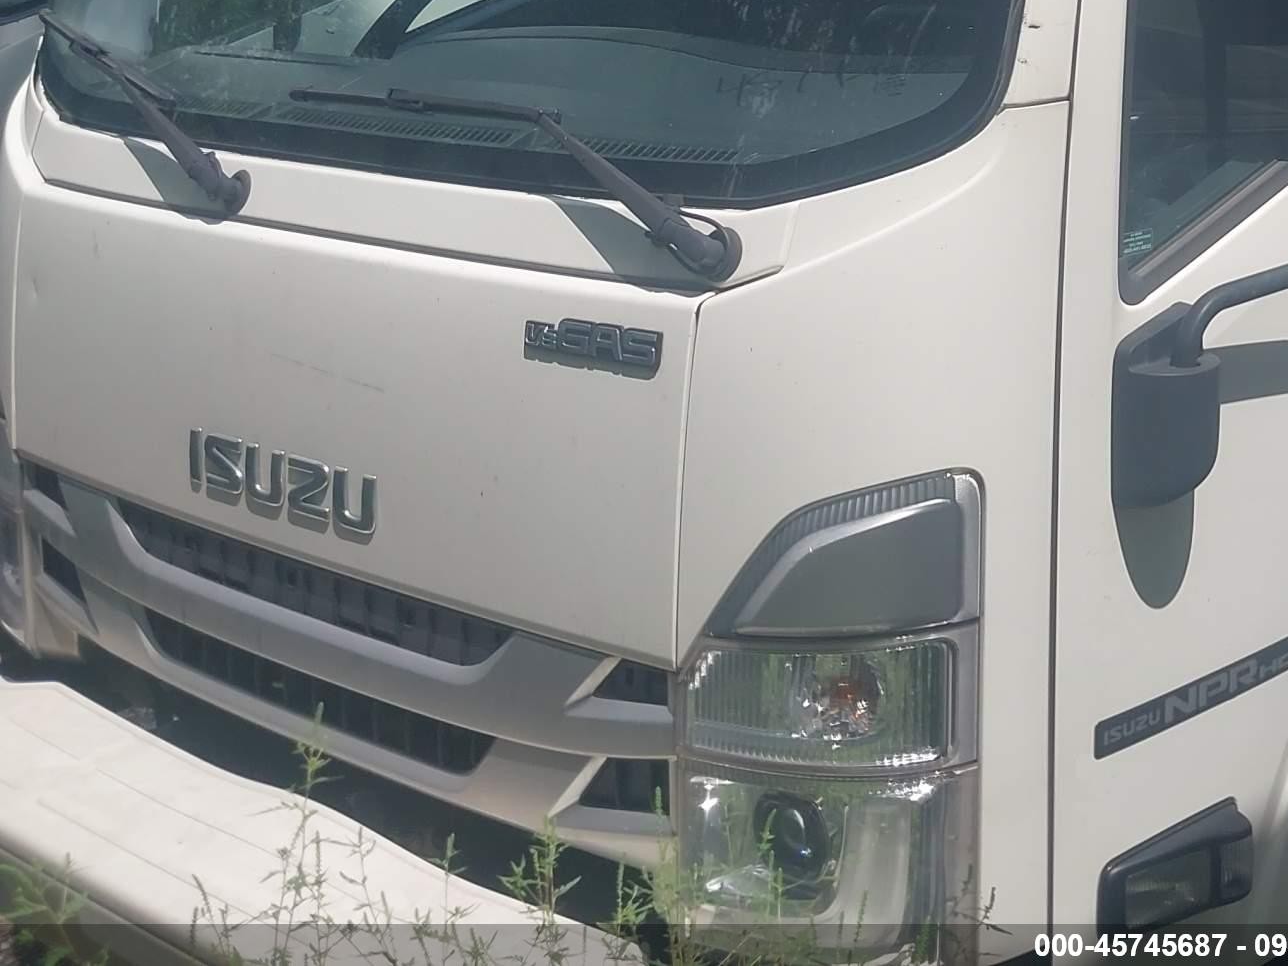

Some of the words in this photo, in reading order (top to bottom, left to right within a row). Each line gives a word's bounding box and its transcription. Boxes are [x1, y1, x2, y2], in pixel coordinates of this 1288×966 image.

[559, 318, 662, 368] GAS
[189, 427, 378, 537] ISUZU
[1103, 708, 1161, 746] ISUZU
[1164, 658, 1259, 724] NPR
